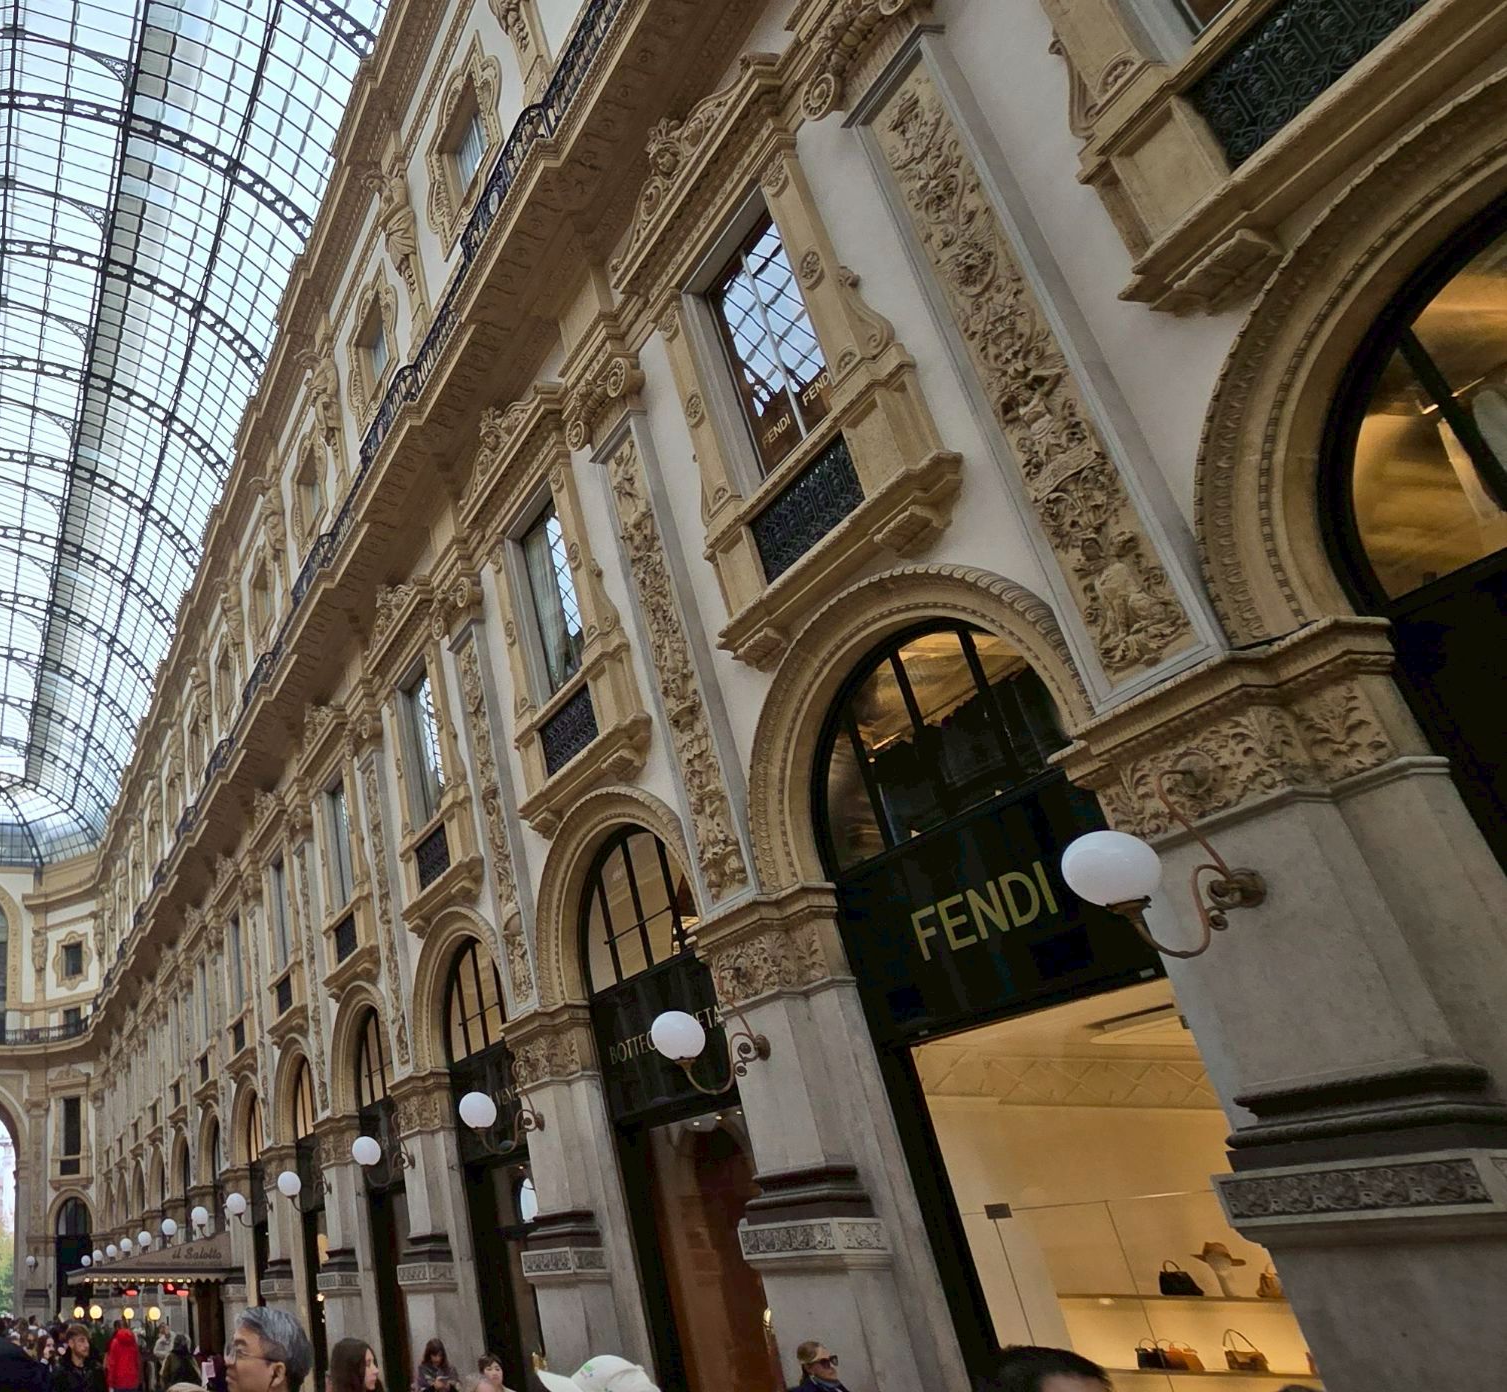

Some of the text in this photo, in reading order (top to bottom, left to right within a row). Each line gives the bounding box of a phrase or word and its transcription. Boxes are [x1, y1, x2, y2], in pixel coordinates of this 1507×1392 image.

[802, 372, 830, 407] FEND
[762, 412, 792, 449] FENDI
[910, 860, 1059, 962] FENDI
[184, 1246, 223, 1260] Salotto
